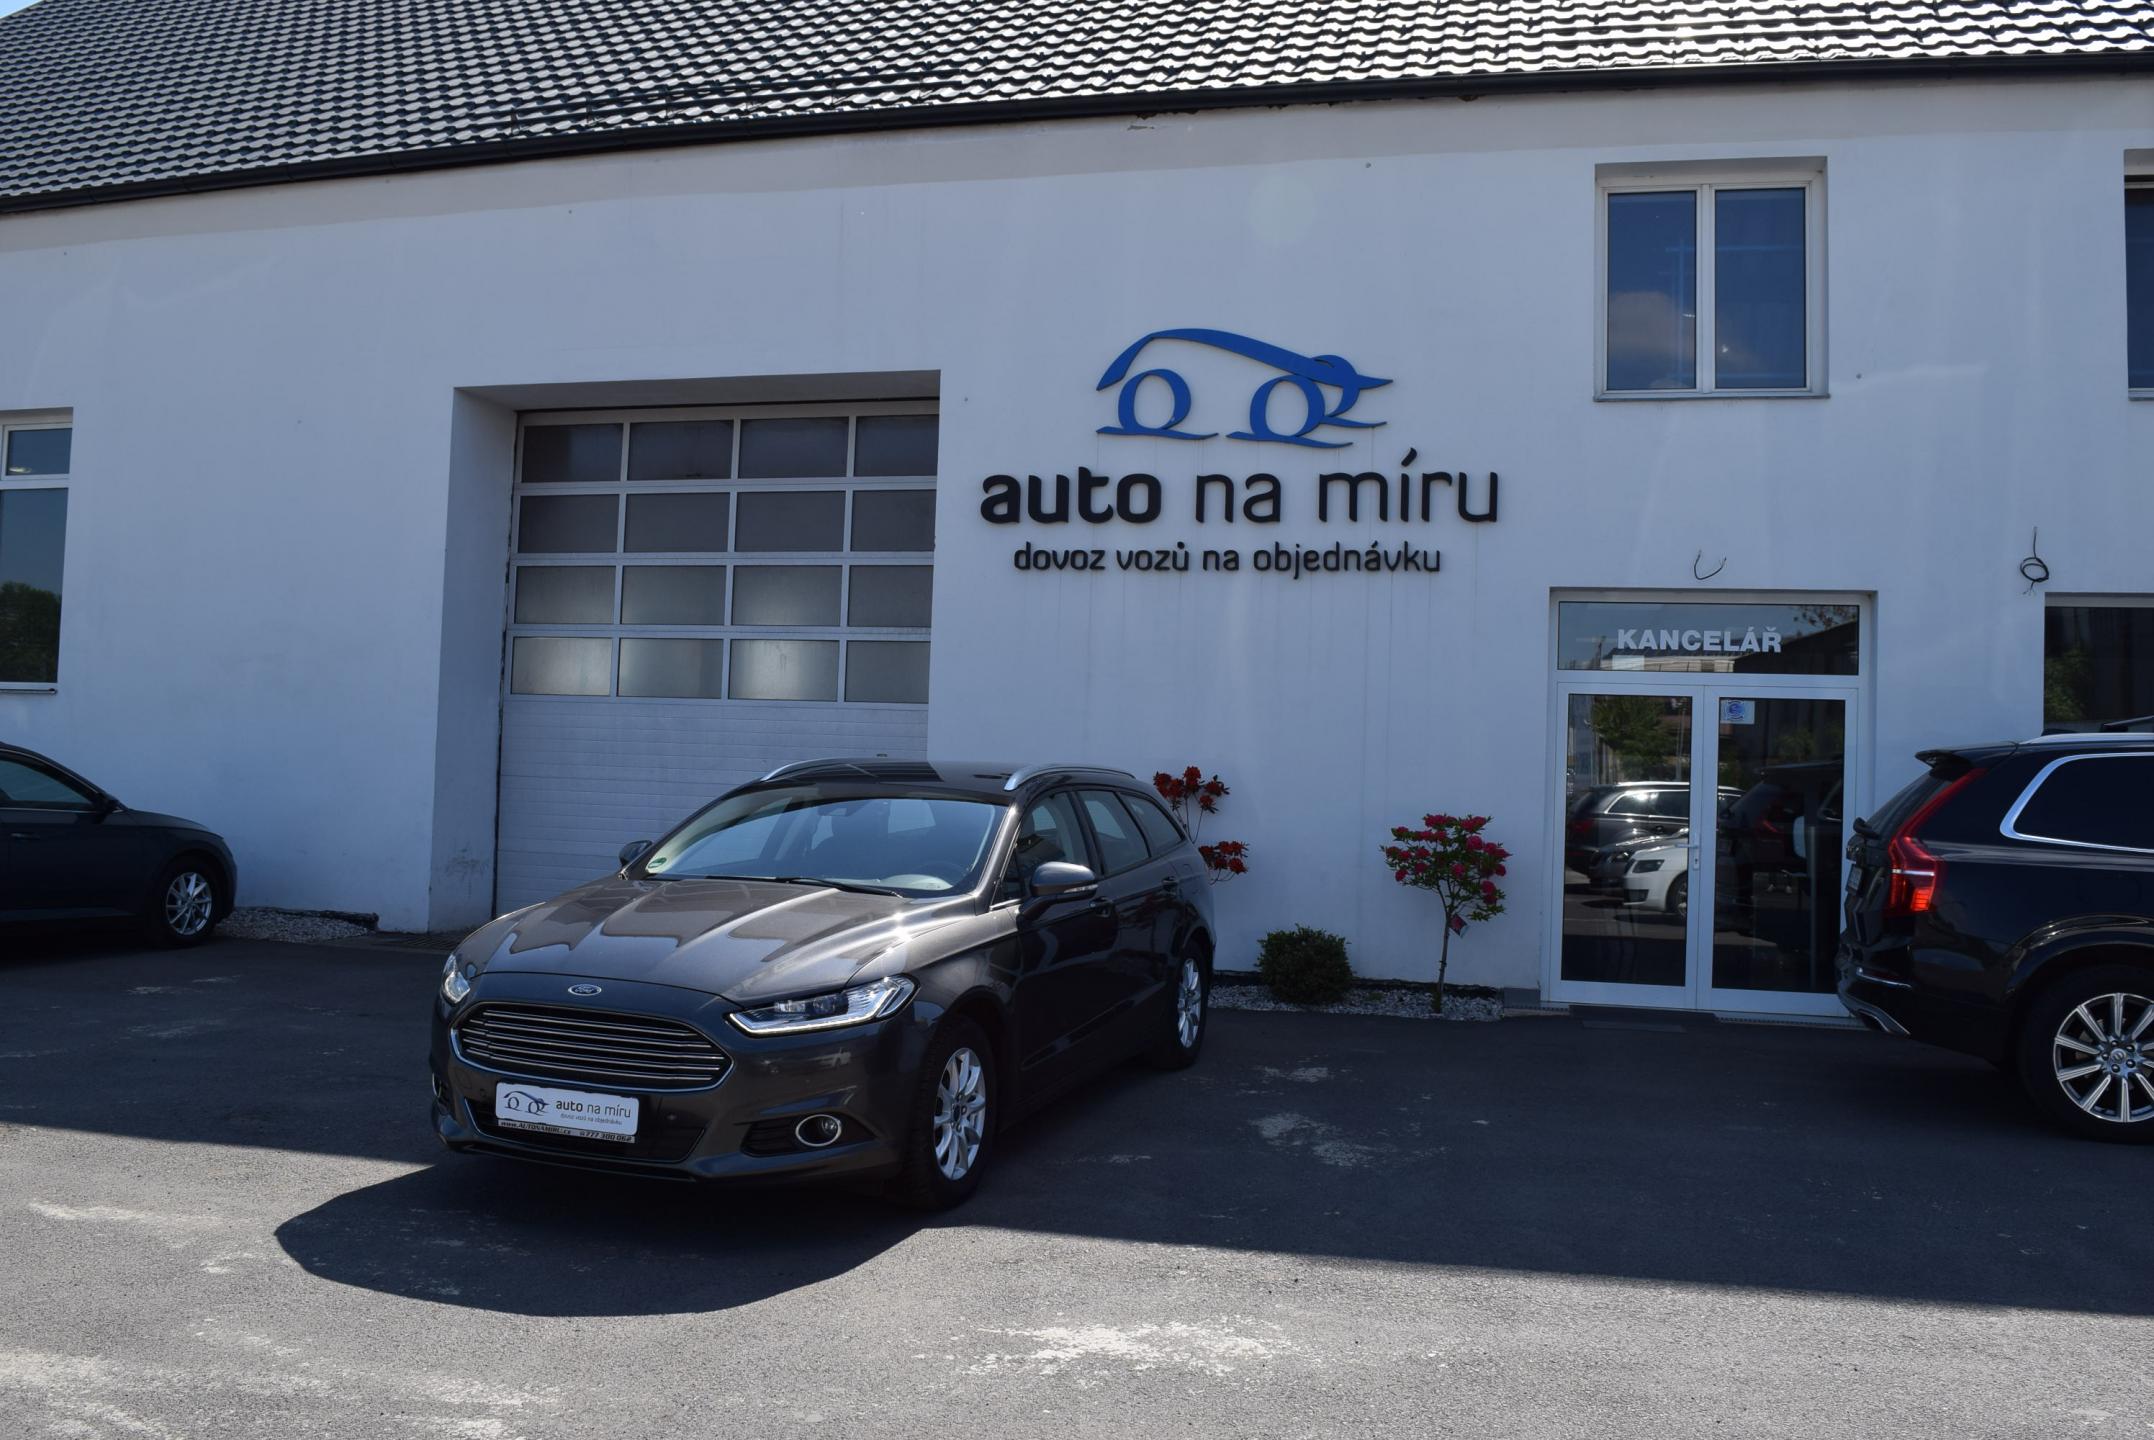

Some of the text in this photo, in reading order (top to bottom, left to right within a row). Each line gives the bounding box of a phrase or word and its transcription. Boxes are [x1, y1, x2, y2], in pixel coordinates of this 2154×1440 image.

[980, 447, 1500, 524] auto na míru
[1013, 540, 1442, 581] dovoz vozů na objednávku
[1617, 627, 1782, 653] KANCELÁŘ
[556, 1099, 631, 1118] auto na míru
